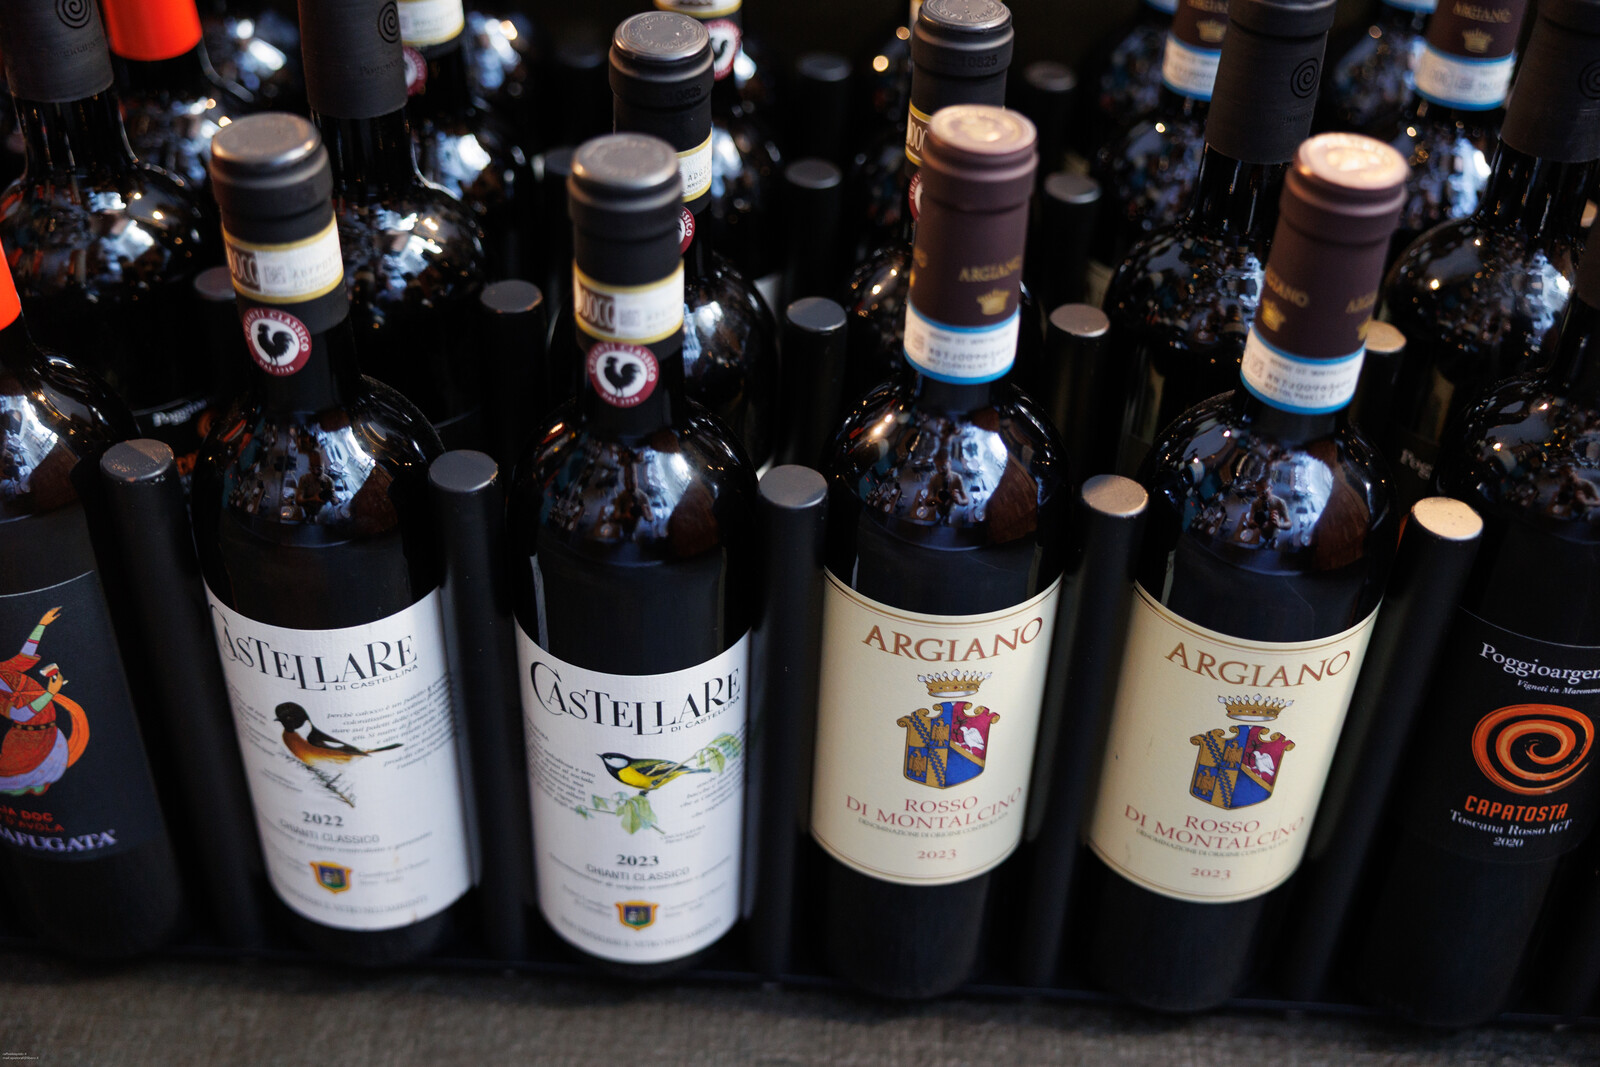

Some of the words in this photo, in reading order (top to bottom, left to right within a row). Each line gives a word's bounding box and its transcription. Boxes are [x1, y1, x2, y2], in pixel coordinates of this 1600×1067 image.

[268, 312, 310, 352] CLASSICO
[210, 604, 418, 691] CASTELLARE
[861, 617, 1043, 663] ARGIANO
[1164, 642, 1351, 687] ARGIANO
[334, 684, 346, 692] DI
[350, 664, 419, 690] CASTELLINA
[1517, 679, 1549, 693] Vigneti
[1550, 685, 1560, 694] in
[530, 661, 741, 735] CASTELLARE
[670, 725, 682, 733] DI
[685, 695, 741, 729] CASTELLINA
[21, 809, 54, 823] DOC
[846, 795, 868, 816] DI
[877, 787, 1022, 829] MONTALCINO
[904, 796, 978, 814] ROSSO
[1464, 795, 1569, 822] CAPATOSTA
[279, 818, 318, 841] CHIANTI
[322, 833, 380, 844] CLASSICO
[301, 811, 344, 827] 2022
[858, 817, 919, 838] DENOMINAZIONE
[1125, 804, 1146, 827] DI
[1154, 816, 1304, 850] MONTALCINO
[1184, 815, 1260, 833] ROSSO
[1450, 809, 1503, 834] Toscana
[1508, 824, 1546, 836] Rosso
[1549, 819, 1573, 834] IGT
[0, 824, 118, 852] AFUGATA
[1493, 836, 1524, 847] 2020
[616, 854, 660, 867] 2023
[917, 849, 957, 860] 2023
[586, 863, 630, 880] CHIANTI
[633, 866, 690, 881] CLASSICO
[1191, 867, 1231, 880] 2023
